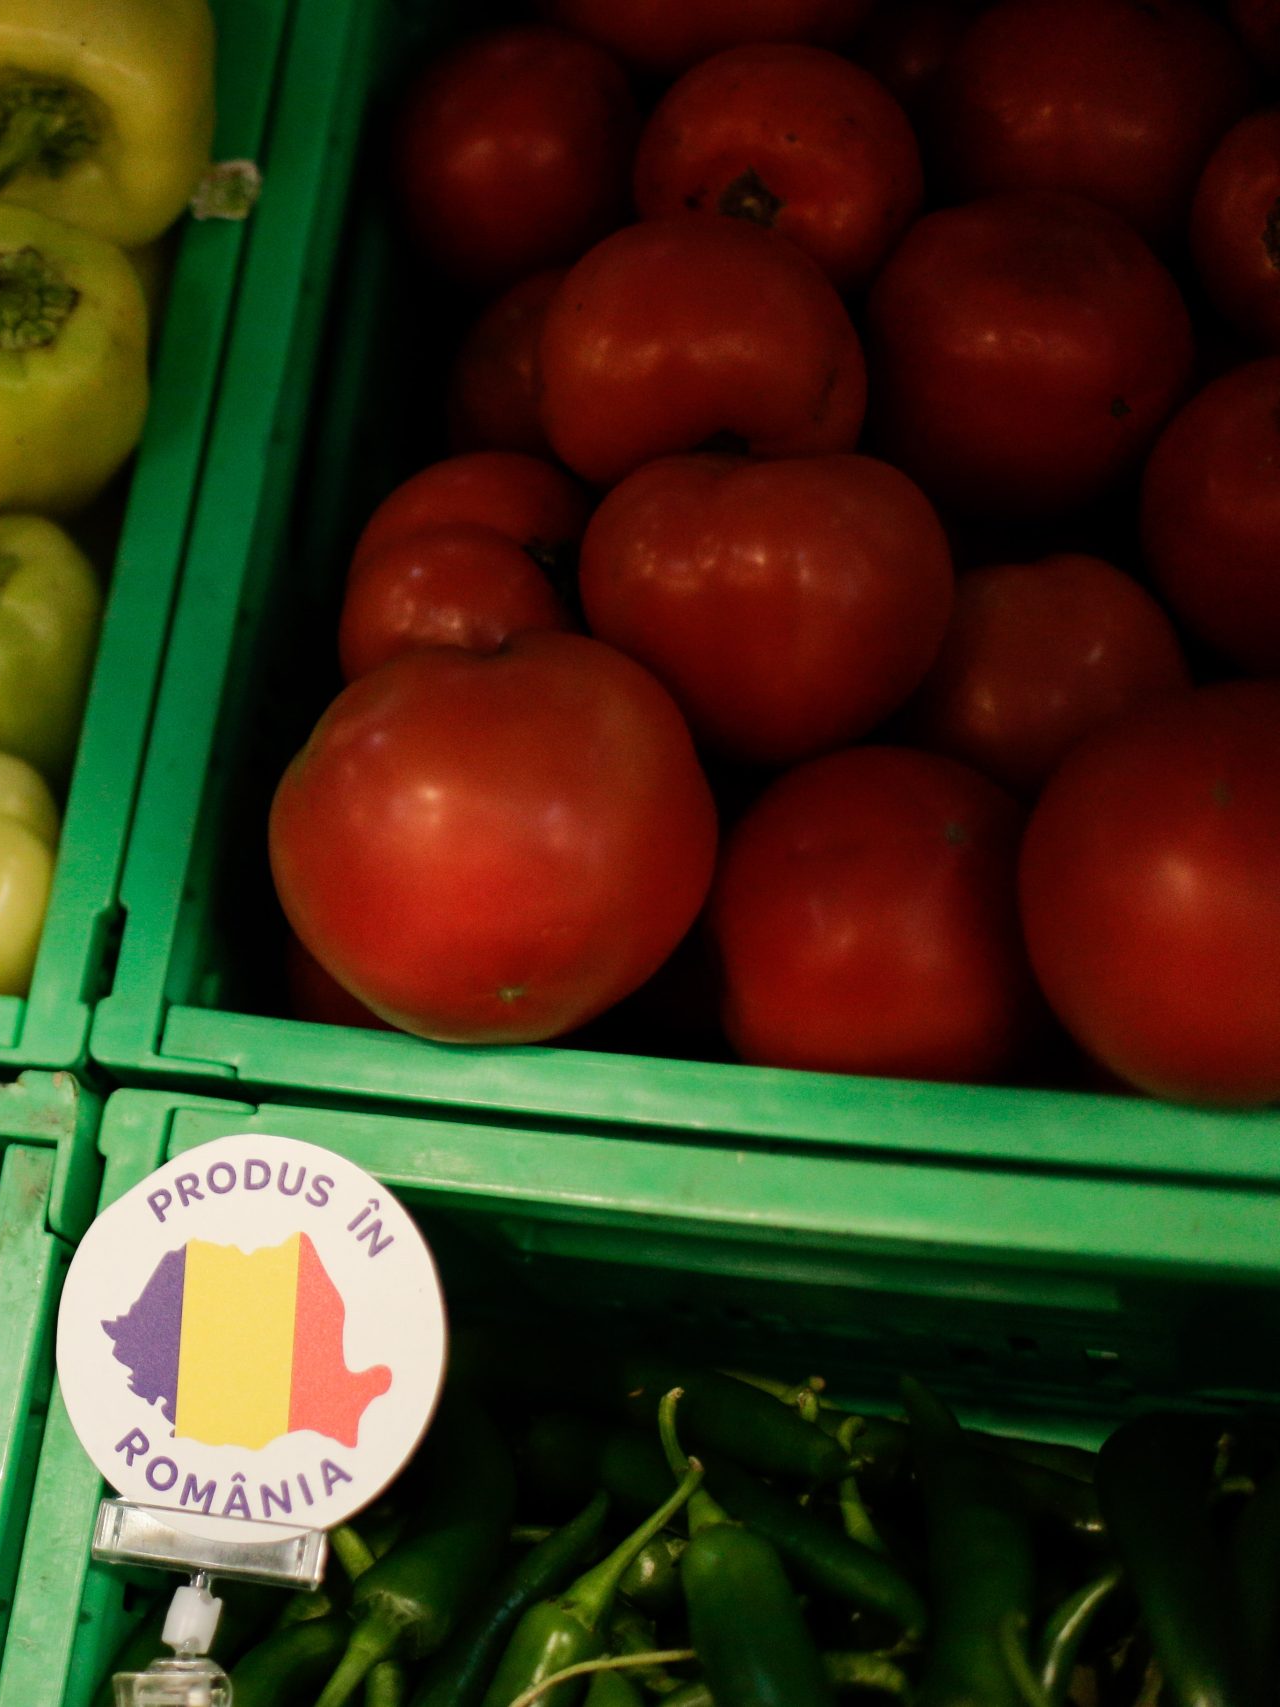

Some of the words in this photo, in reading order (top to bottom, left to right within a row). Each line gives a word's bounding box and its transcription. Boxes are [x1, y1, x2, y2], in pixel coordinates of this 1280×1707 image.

[147, 1159, 335, 1222] PRODUS
[347, 1199, 394, 1257] ÎN
[115, 1428, 352, 1519] ROMÂNIA
